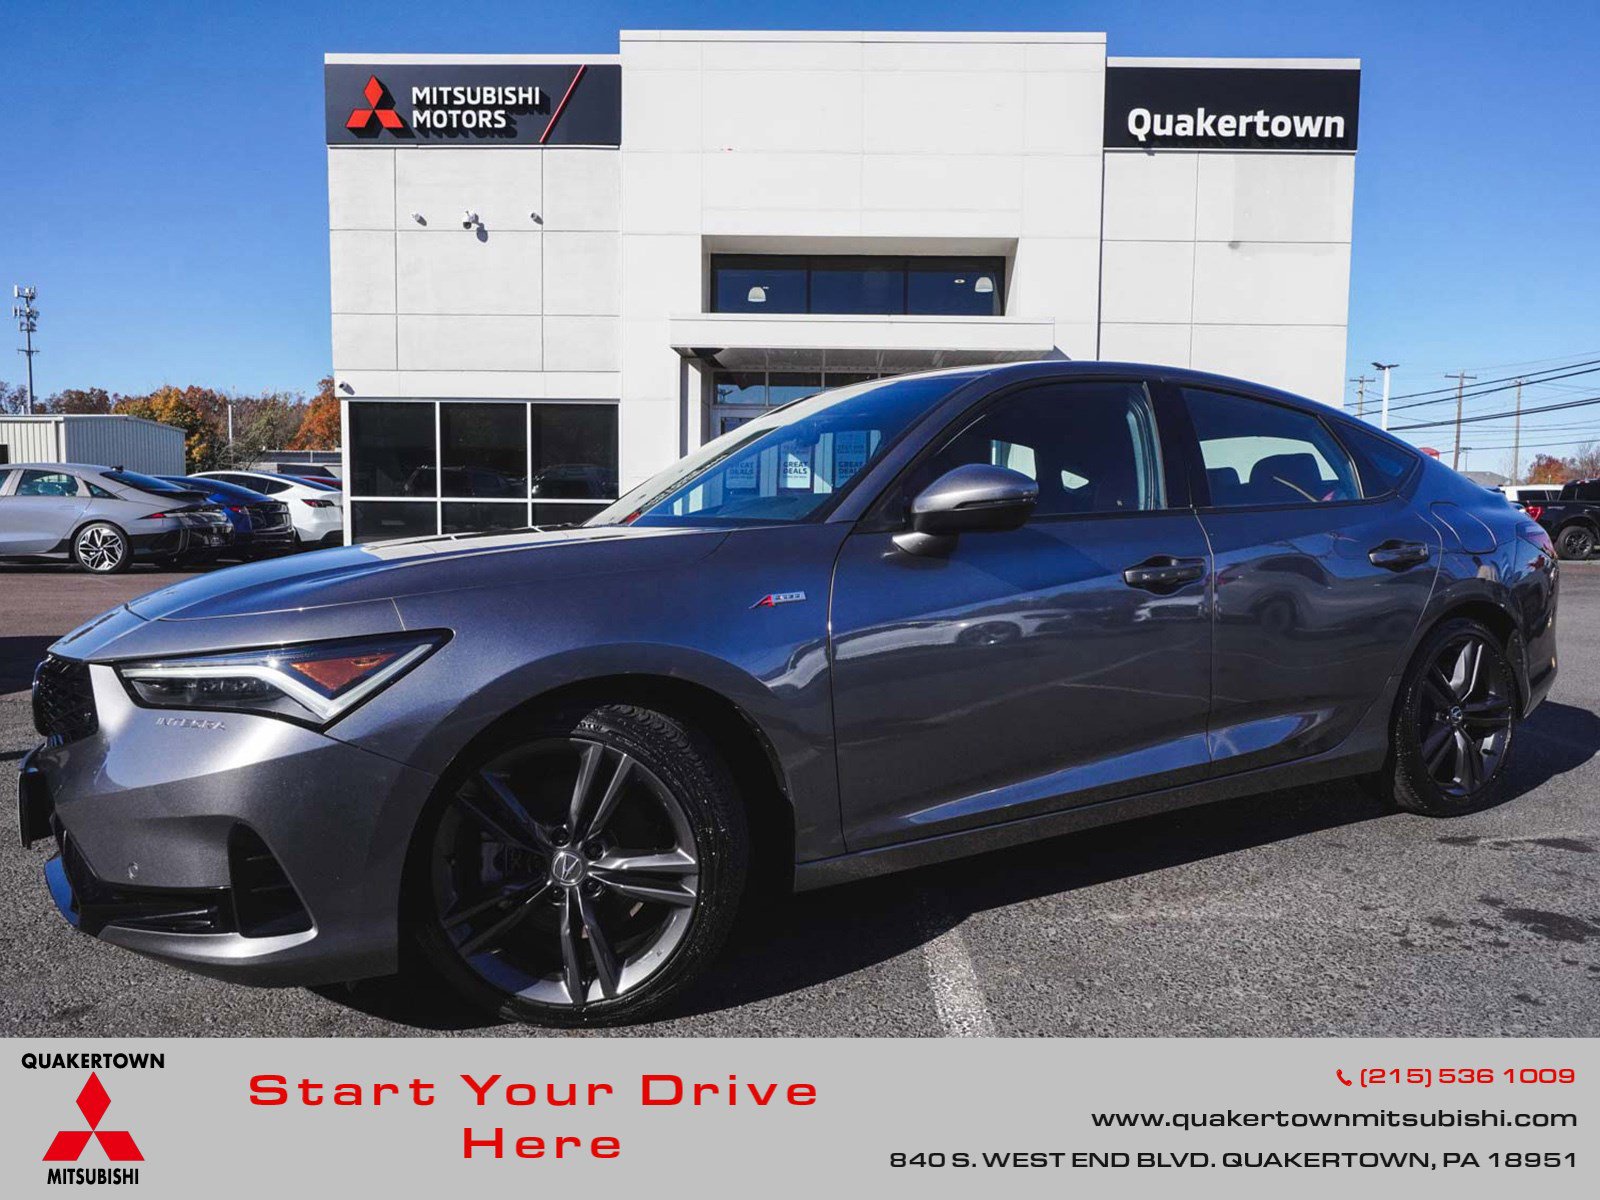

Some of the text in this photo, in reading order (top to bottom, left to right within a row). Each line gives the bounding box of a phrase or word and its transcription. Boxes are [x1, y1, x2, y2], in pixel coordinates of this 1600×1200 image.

[412, 86, 540, 105] MITSUBISHI
[412, 110, 507, 128] MOTORS
[1127, 107, 1345, 142] Quakertown
